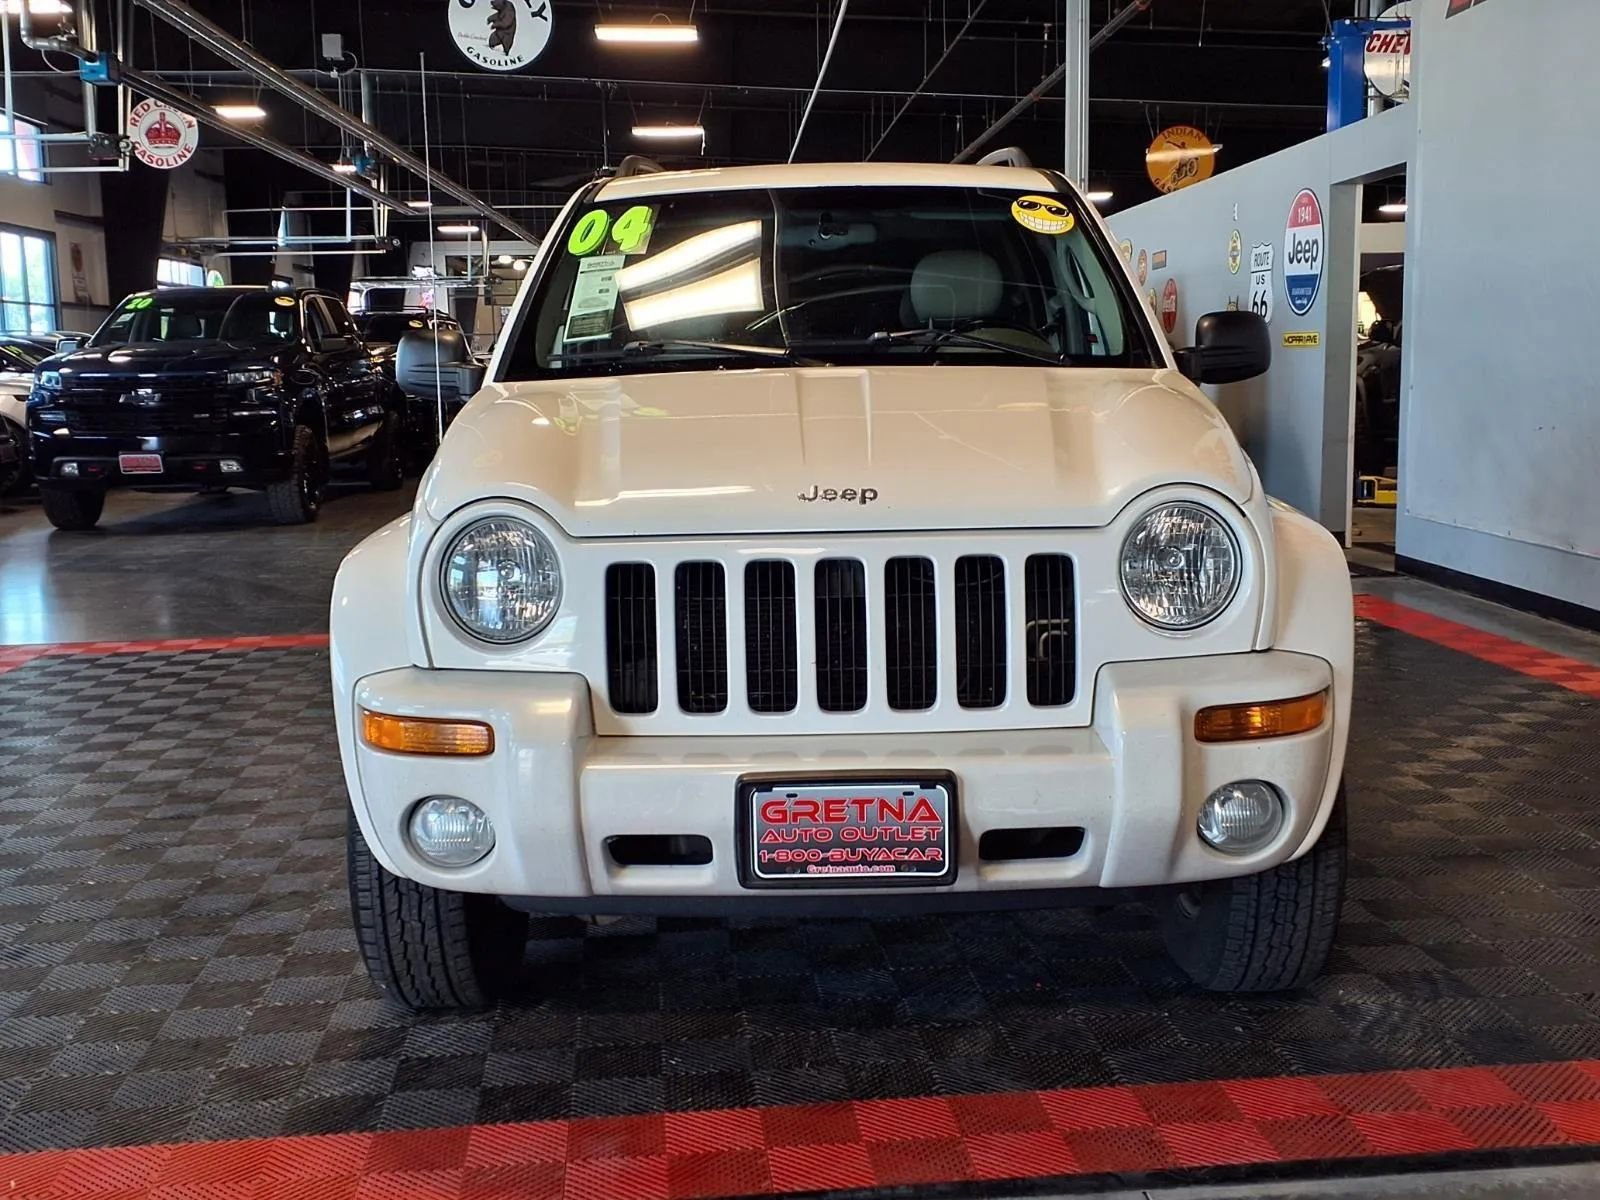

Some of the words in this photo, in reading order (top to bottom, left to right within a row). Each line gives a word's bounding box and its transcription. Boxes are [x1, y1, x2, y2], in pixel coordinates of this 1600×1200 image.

[466, 46, 524, 67] GASOLINE
[130, 103, 151, 127] RED
[1162, 127, 1203, 142] INDIAN
[1298, 205, 1312, 223] 1941
[567, 205, 653, 257] 04
[1253, 251, 1270, 268] ROUTE
[1288, 232, 1319, 270] Jeep
[1255, 274, 1266, 286] US
[1251, 289, 1268, 319] 66
[797, 484, 878, 505] Jeep
[760, 797, 942, 825] GRETNA
[760, 829, 833, 844] AUTO
[840, 827, 943, 842] OUTLET
[760, 848, 942, 863] 1-800-BUYACAR
